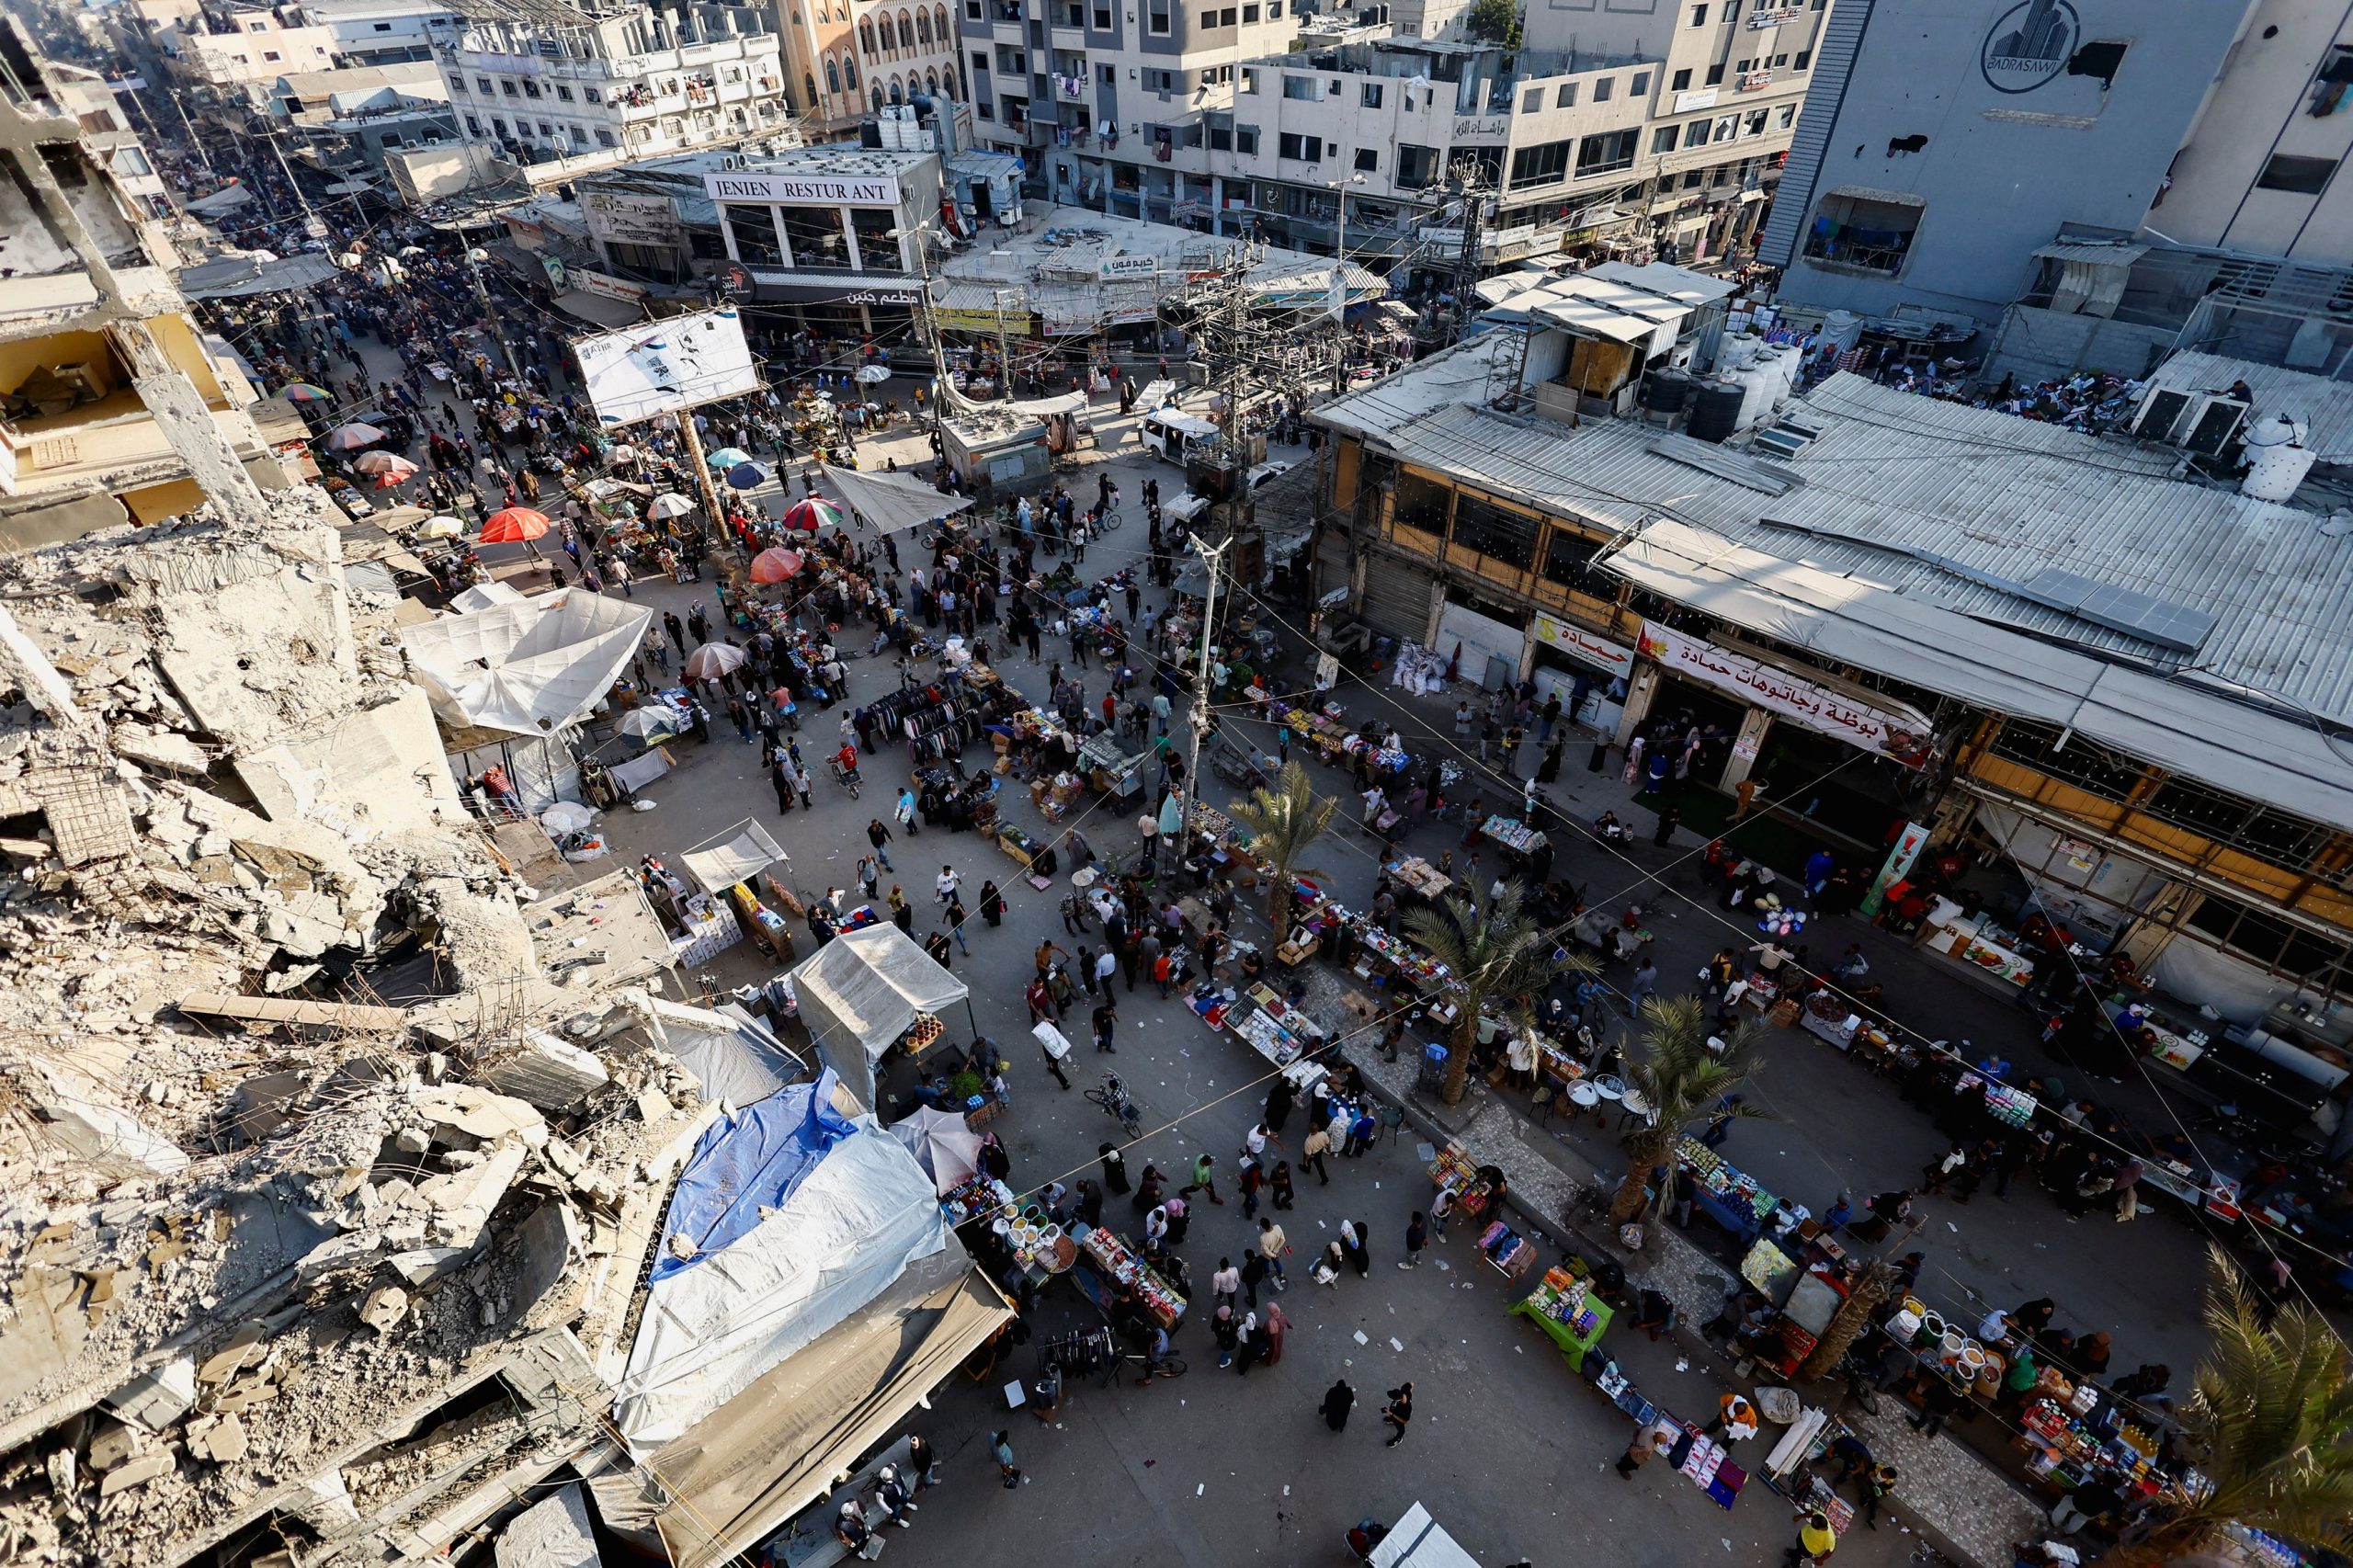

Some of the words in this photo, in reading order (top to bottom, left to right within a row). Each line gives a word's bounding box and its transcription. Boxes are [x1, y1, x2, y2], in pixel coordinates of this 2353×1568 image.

[1986, 57, 2057, 74] BADRASAWI
[715, 180, 772, 198] JENIEN
[1111, 258, 1131, 270] فون
[1132, 256, 1154, 268] كريم
[847, 291, 878, 306] جنين
[880, 290, 919, 306] مطعم
[1680, 645, 1732, 676] حمادة
[1734, 668, 1821, 715] وجاتوهات
[1824, 702, 1880, 739] بوظة
